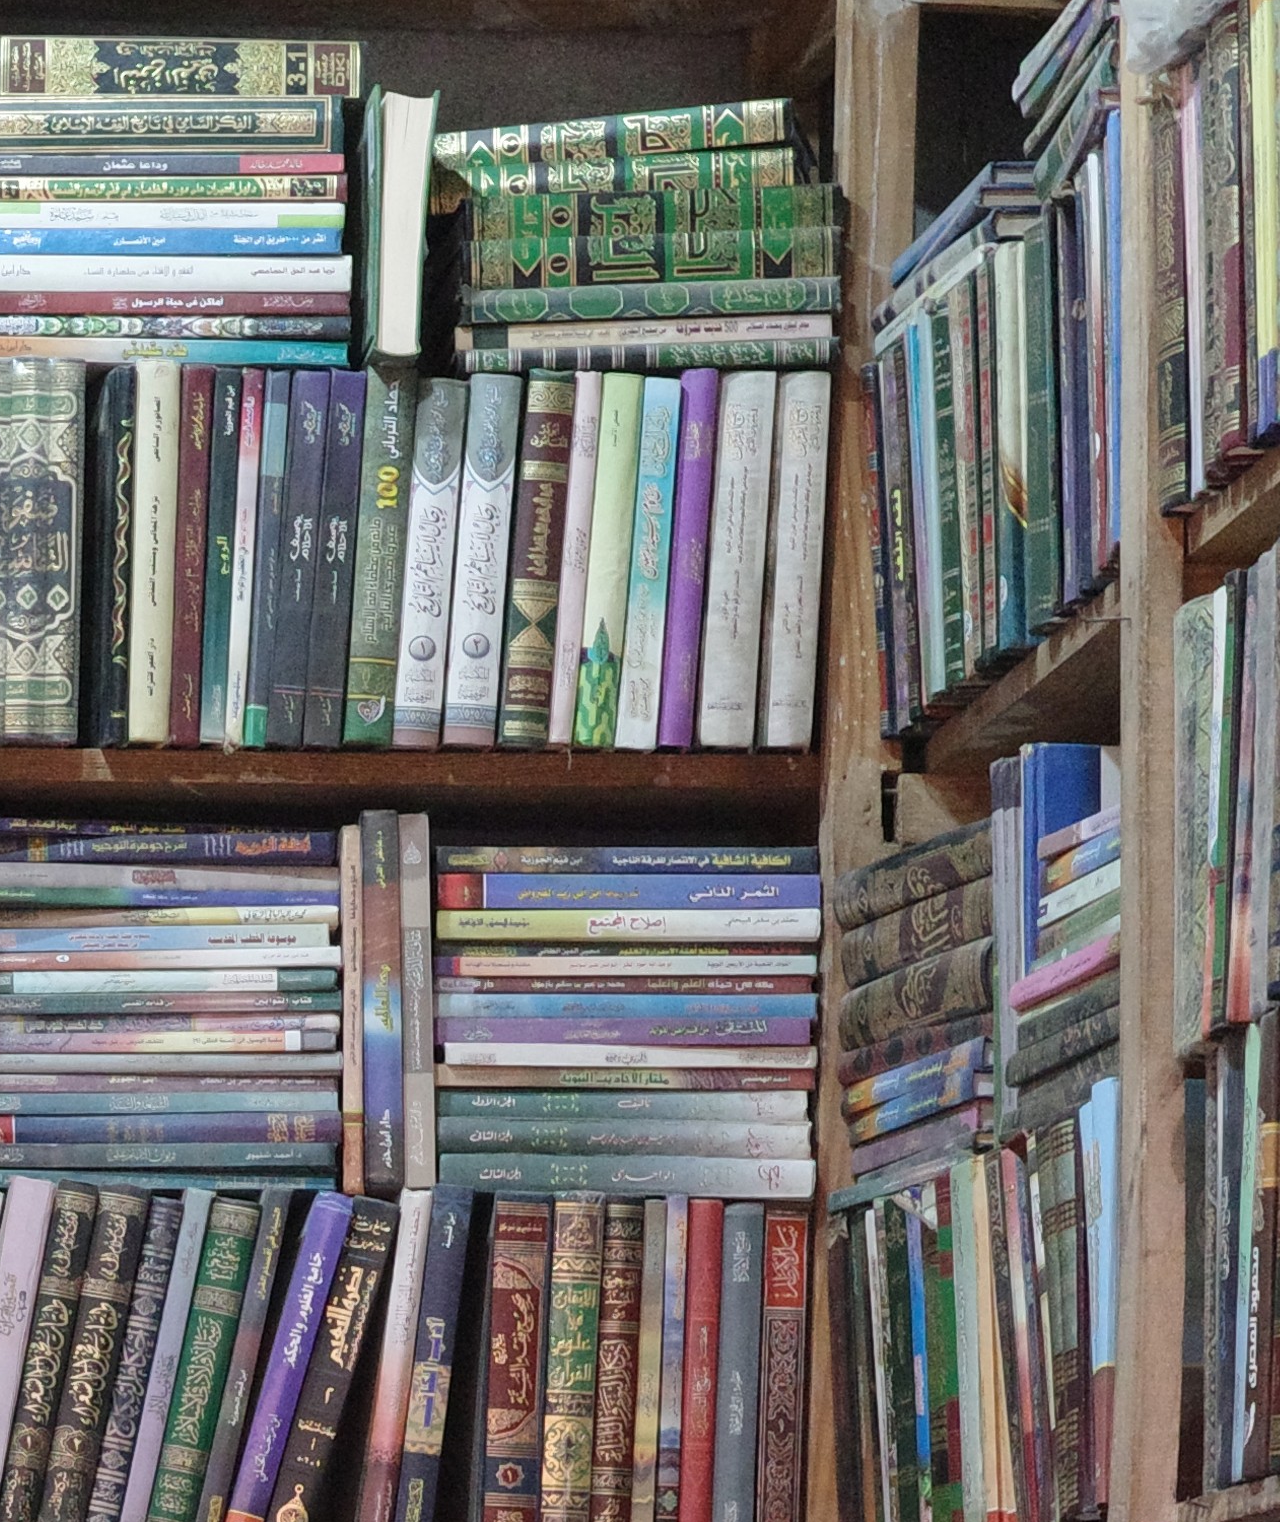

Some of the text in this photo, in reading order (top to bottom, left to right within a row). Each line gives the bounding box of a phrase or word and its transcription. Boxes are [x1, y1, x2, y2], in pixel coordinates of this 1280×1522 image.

[376, 466, 400, 509] 100
[217, 536, 232, 575] الروح
[891, 489, 904, 582] فقه اللغة
[302, 1251, 325, 1284] جامع
[1249, 1246, 1260, 1314] محمود
[323, 1308, 354, 1366] النعيم
